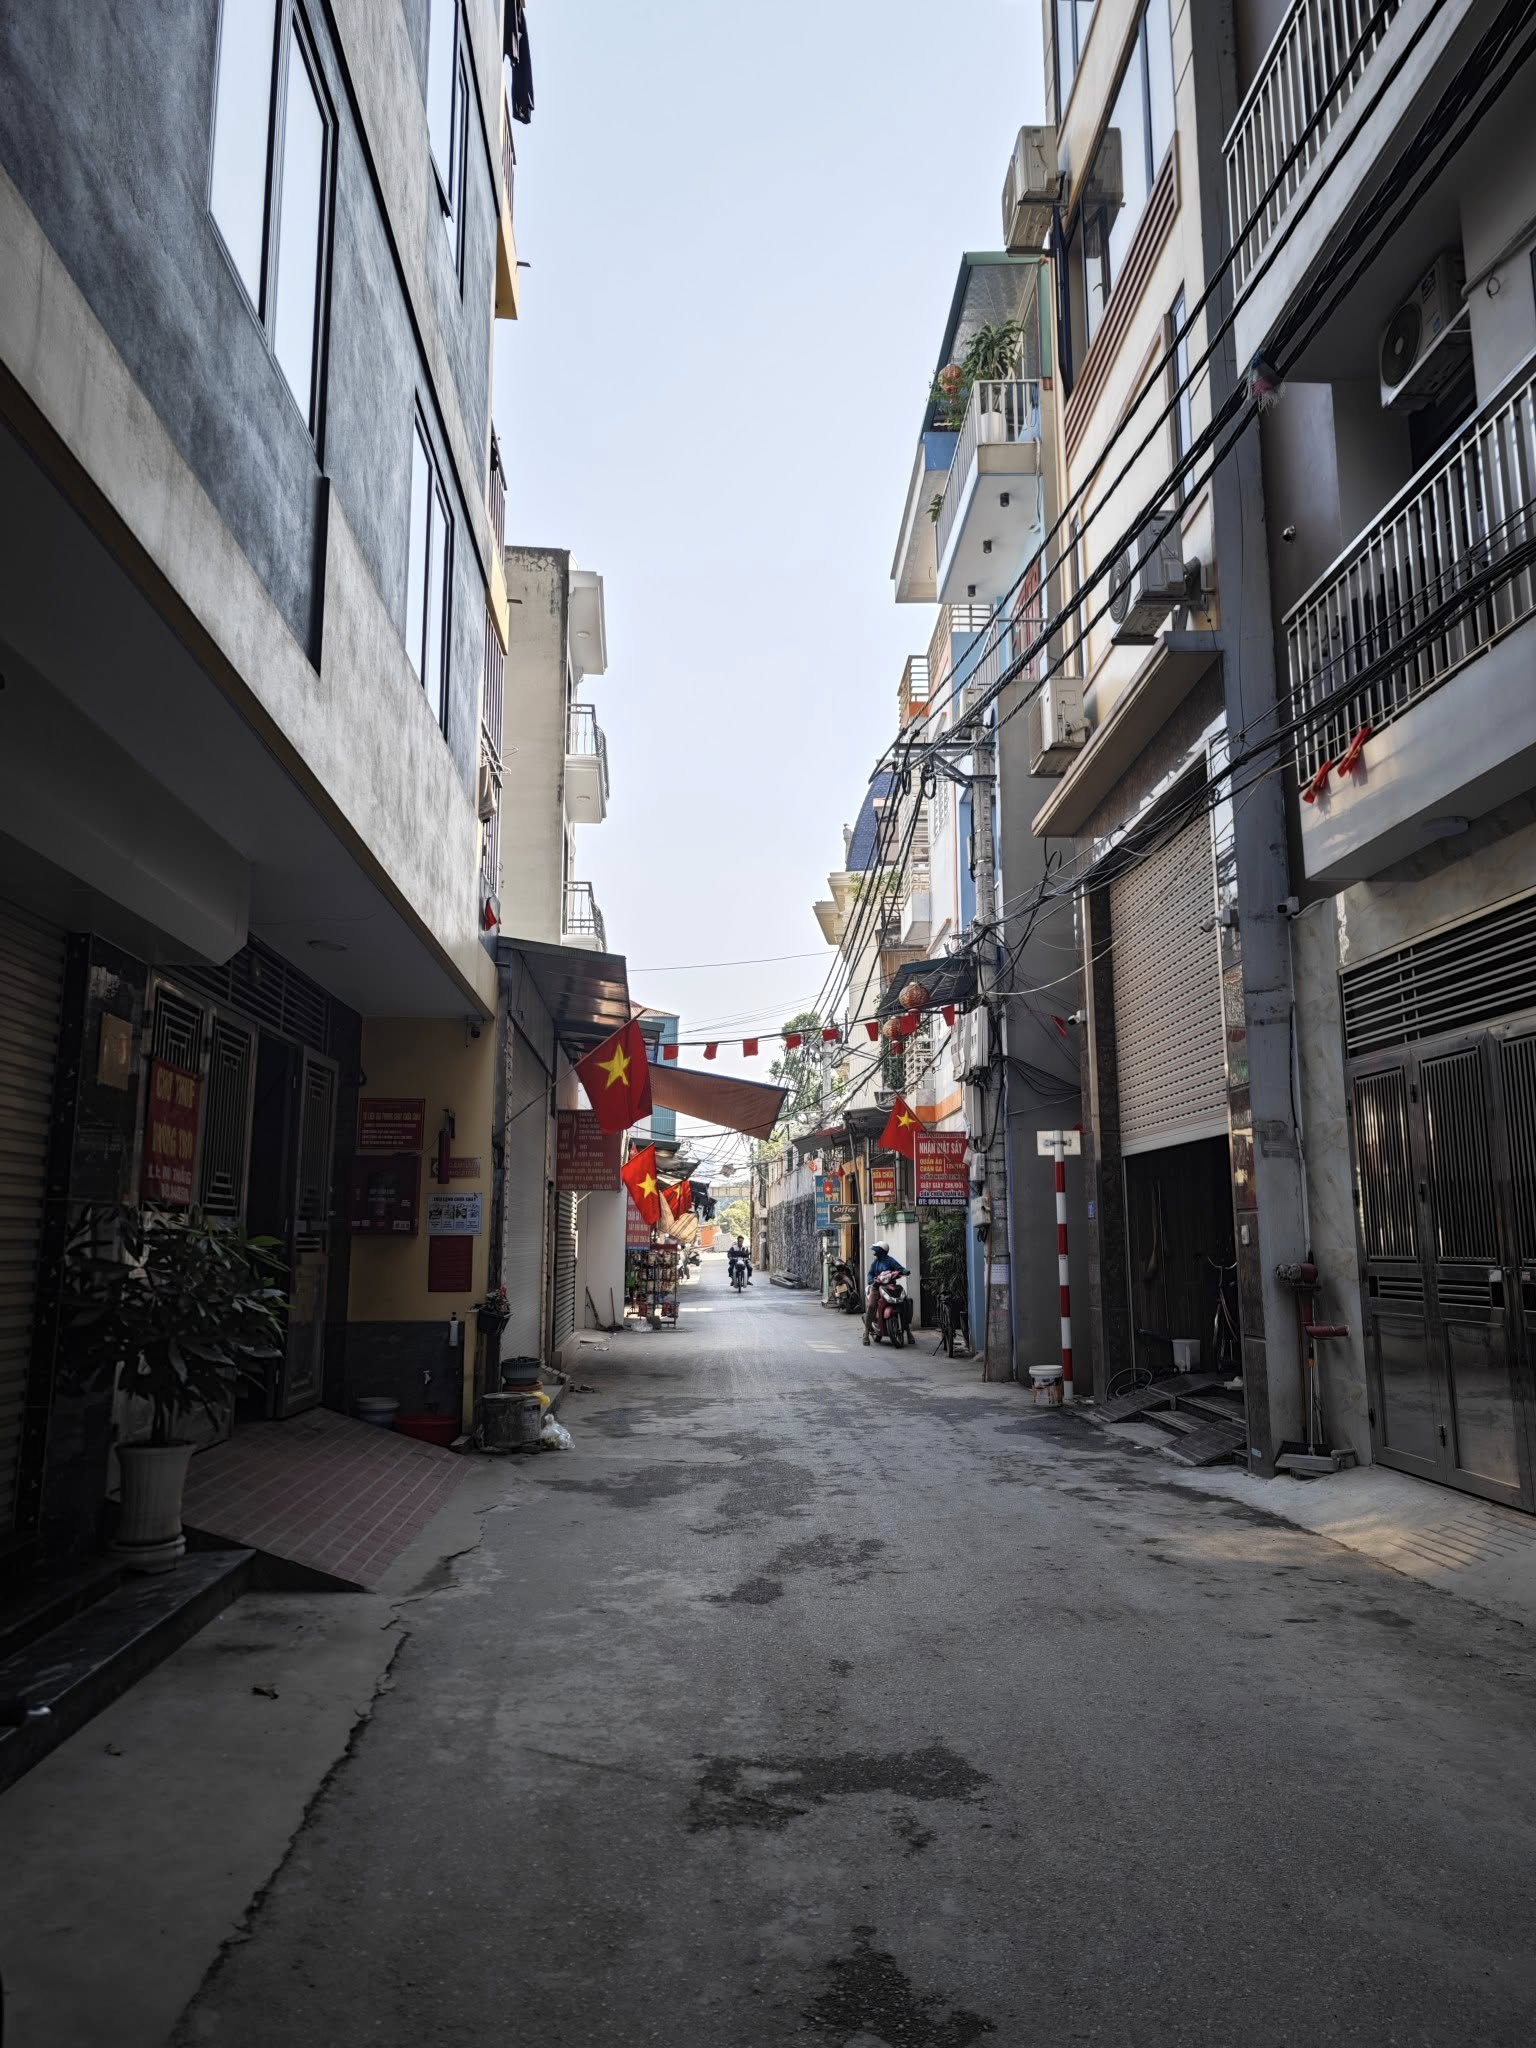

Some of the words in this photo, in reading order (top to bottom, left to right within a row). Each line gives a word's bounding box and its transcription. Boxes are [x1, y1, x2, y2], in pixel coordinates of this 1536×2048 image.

[920, 1140, 936, 1157] NHẬN
[951, 1140, 962, 1154] SẤY
[832, 1205, 856, 1213] Coffee
